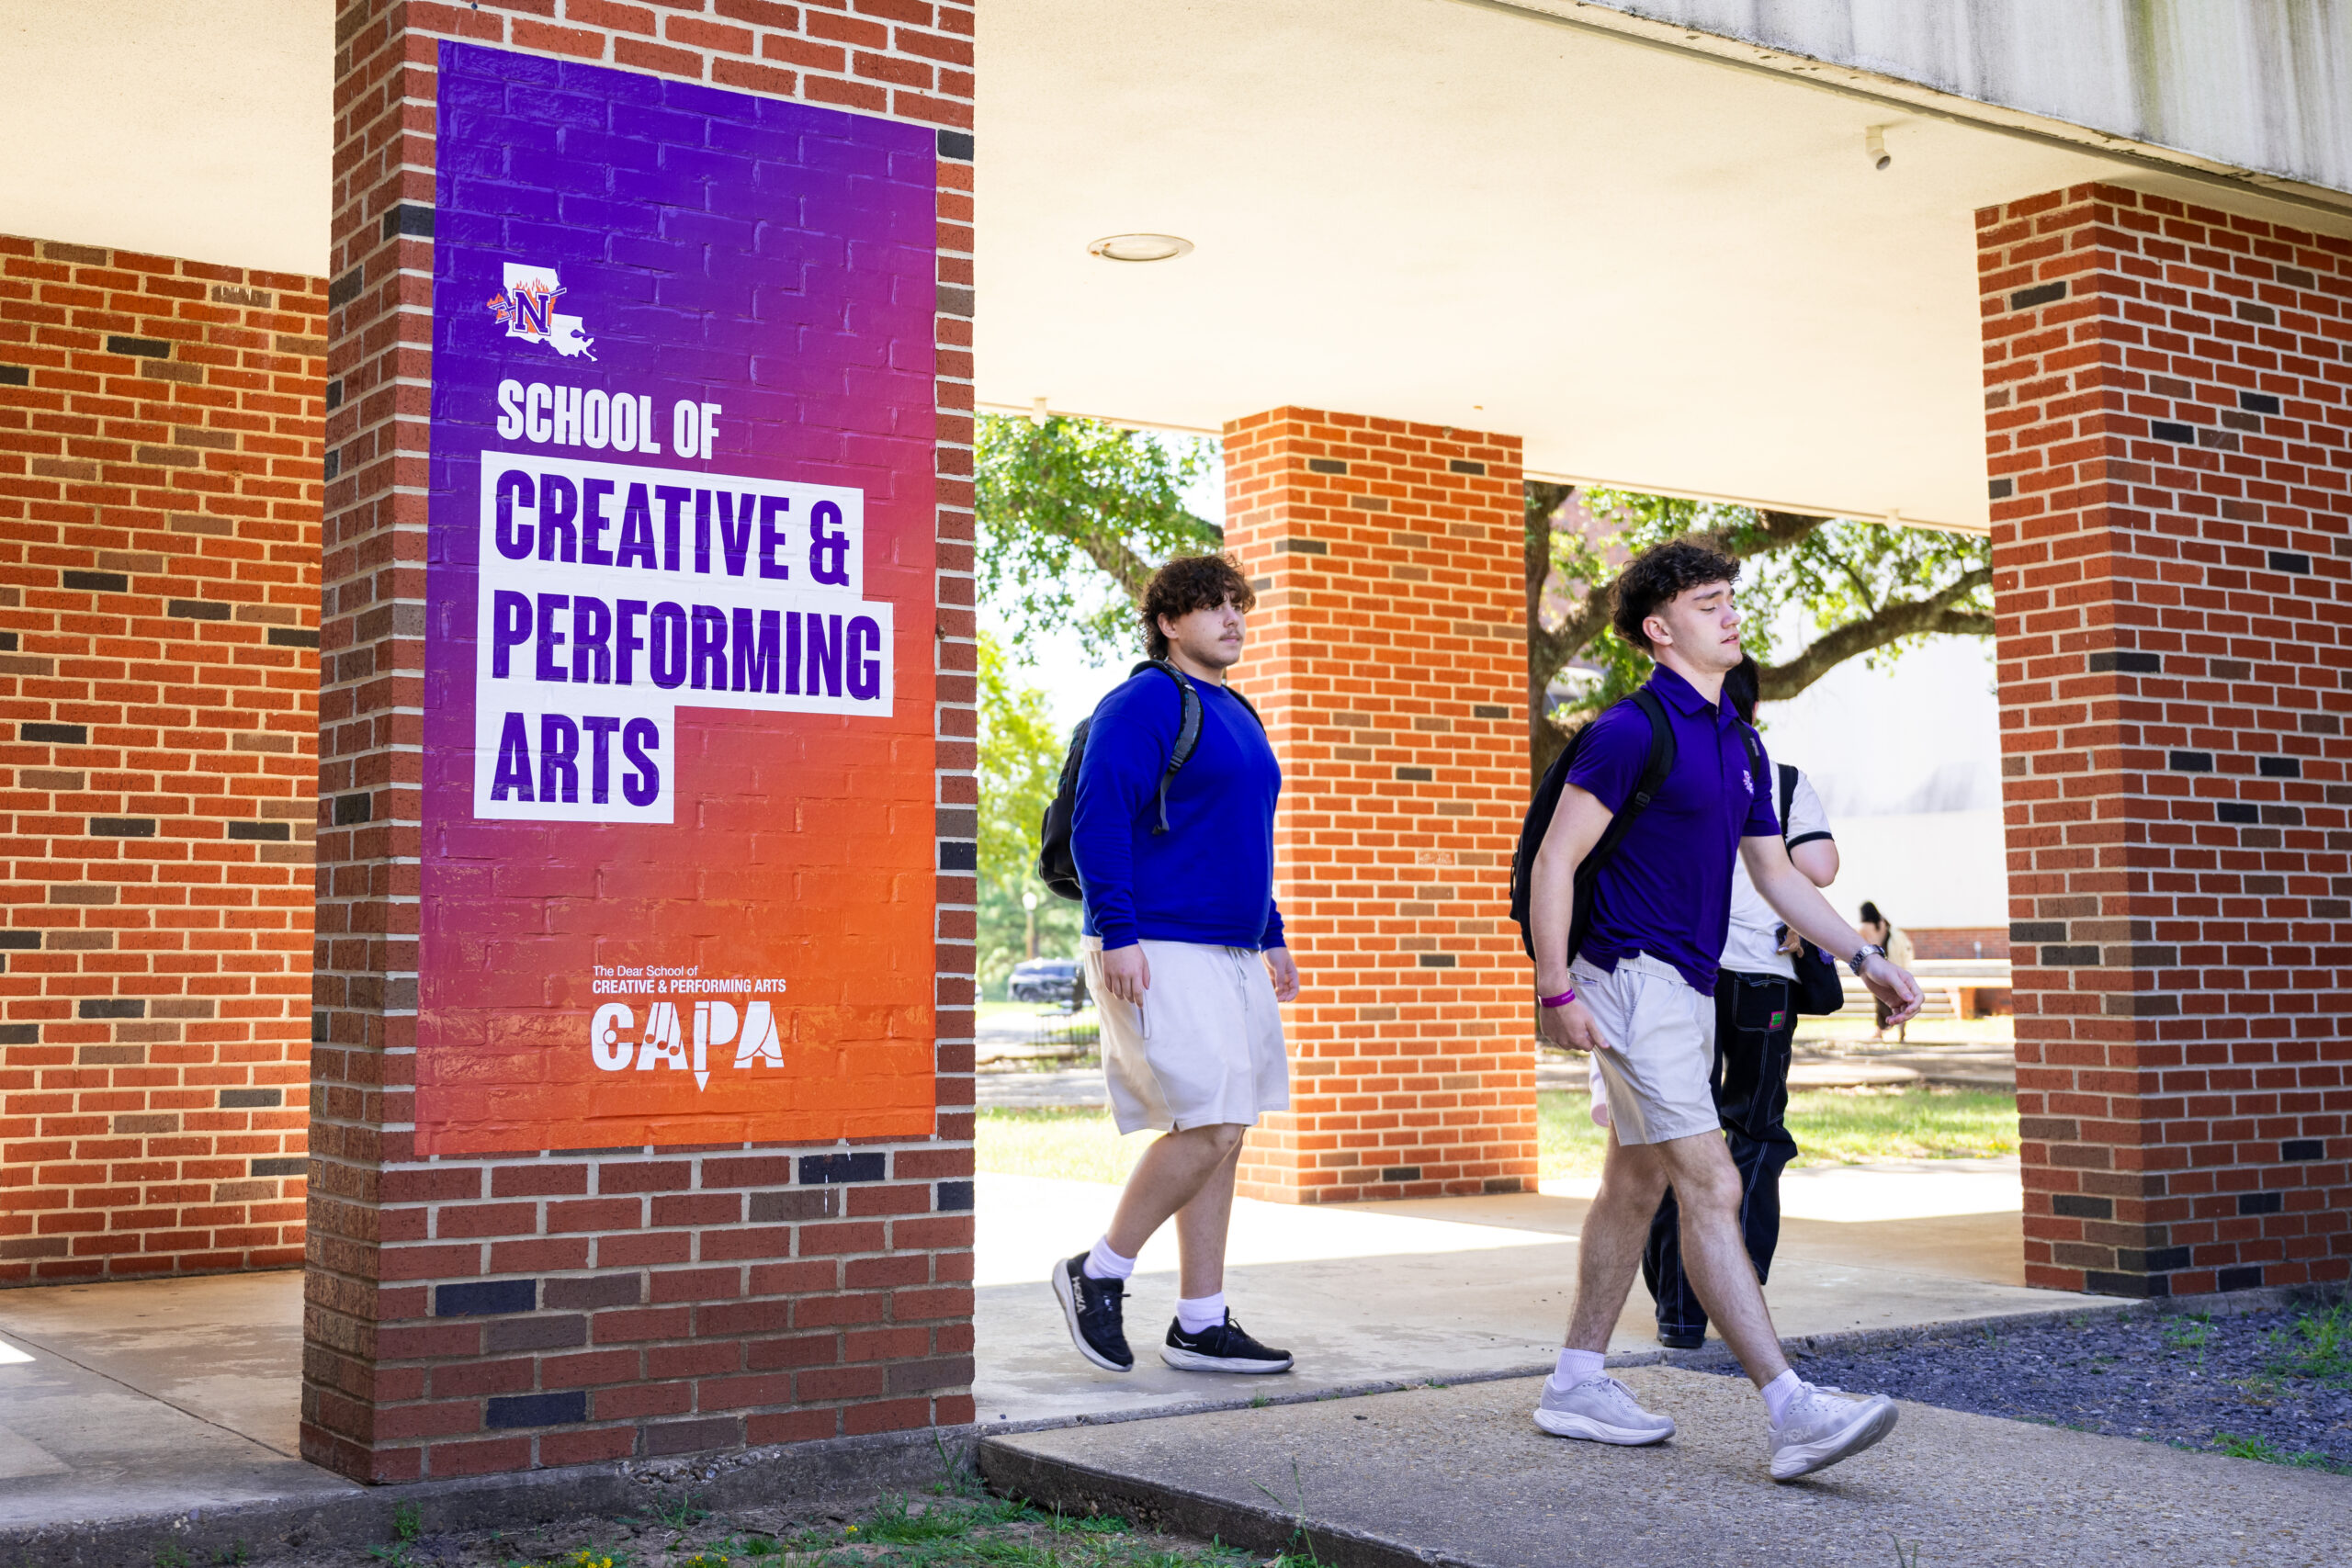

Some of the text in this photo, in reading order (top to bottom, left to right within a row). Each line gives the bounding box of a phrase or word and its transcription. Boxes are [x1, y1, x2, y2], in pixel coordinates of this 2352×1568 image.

[513, 288, 551, 336] N
[496, 378, 722, 459] SCHOOL OF
[494, 468, 851, 587] CREATIVE &
[492, 589, 881, 701] PERFORMING
[490, 711, 661, 807] ARTS
[593, 964, 698, 976] The Dear School of
[593, 978, 786, 994] CREATIVE & PERFORMING ARTS
[591, 1000, 785, 1092] CAPA
[1071, 1276, 1087, 1314] HOKA
[1782, 1425, 1813, 1443] HOKA
